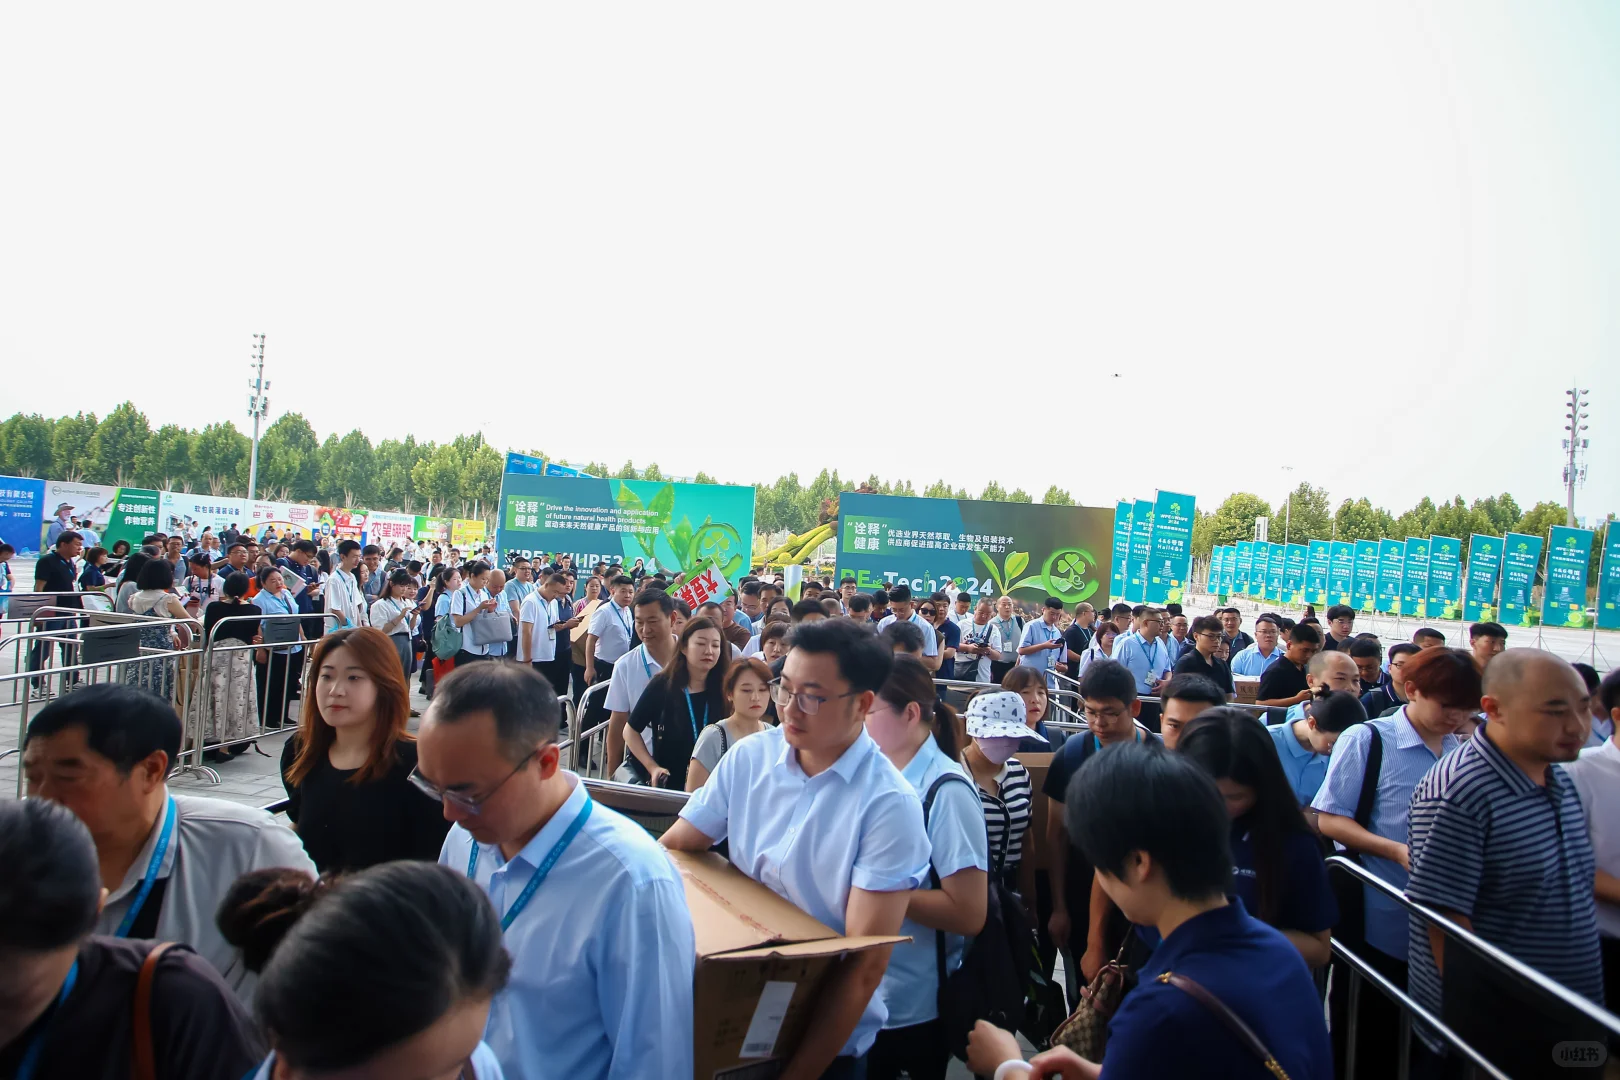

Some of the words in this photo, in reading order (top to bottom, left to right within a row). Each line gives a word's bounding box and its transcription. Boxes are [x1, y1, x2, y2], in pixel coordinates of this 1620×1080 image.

[118, 503, 156, 514] 专注创新性
[546, 504, 562, 512] Drive
[575, 505, 608, 514] innovation
[609, 507, 621, 515] and
[623, 507, 659, 517] application
[124, 516, 156, 525] 作物营养
[514, 514, 539, 528] 健康
[573, 513, 595, 521] natural
[596, 514, 616, 522] health
[617, 515, 646, 524] products
[544, 520, 659, 534] 驱动未来天然健康产品的创新与应用
[853, 536, 880, 551] 健康
[887, 538, 1005, 553] 供应商促进提高企业研发生产能力
